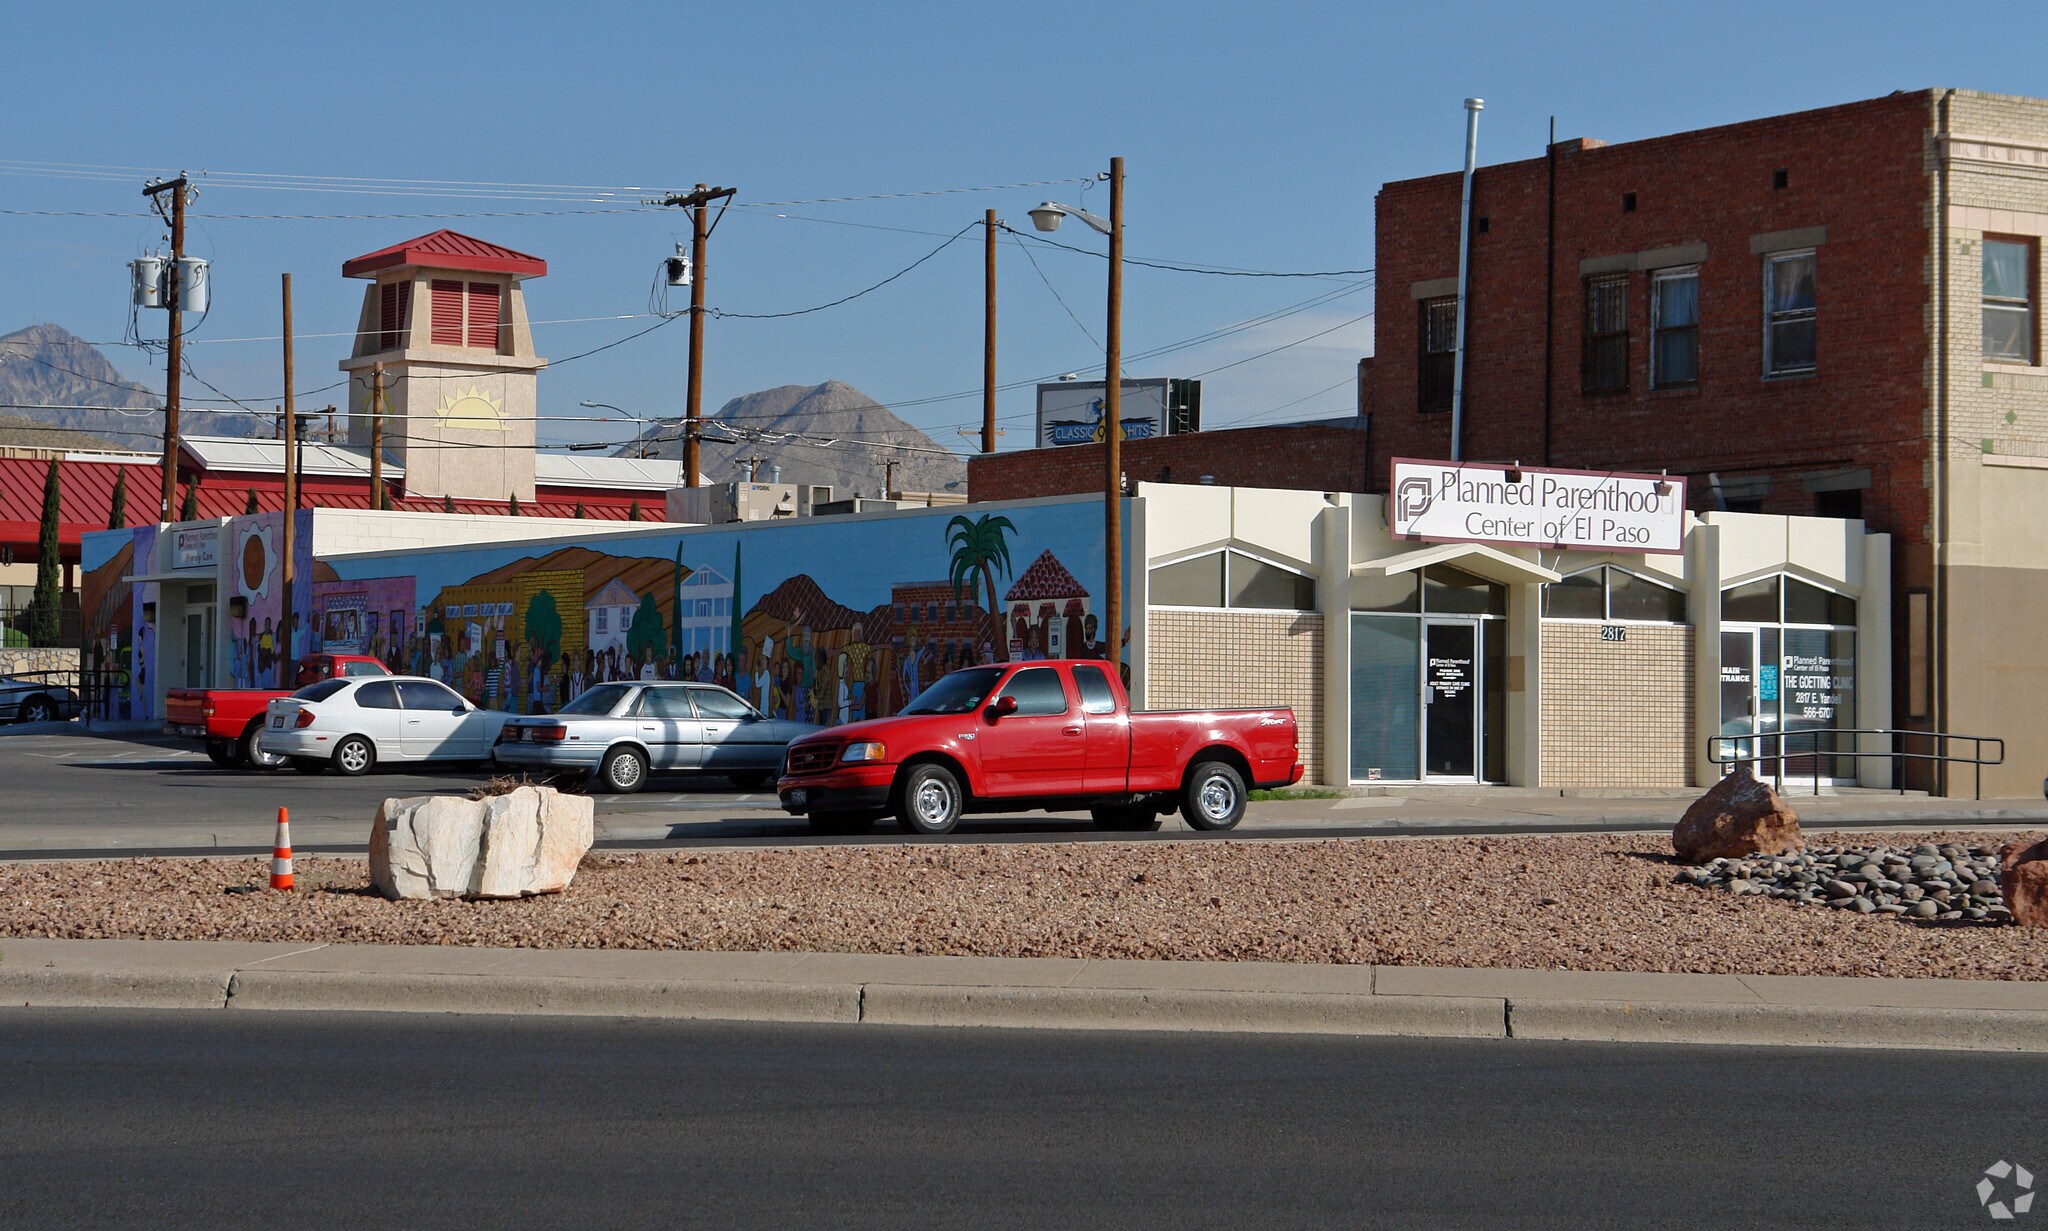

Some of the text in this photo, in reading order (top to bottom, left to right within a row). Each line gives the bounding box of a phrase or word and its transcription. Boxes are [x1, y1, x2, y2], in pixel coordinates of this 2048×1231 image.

[1055, 426, 1094, 439] CLASSIC
[1127, 424, 1149, 437] HITS
[1441, 469, 1534, 506] Planned
[1465, 511, 1650, 544] Center of El Paso
[203, 551, 213, 561] Care
[1602, 626, 1626, 641] 2817
[1793, 655, 1818, 665] Planned
[1721, 666, 1740, 674] MAIN
[1720, 674, 1750, 682] TRANCE
[1784, 675, 1854, 689] THE GOETTING CLINIC
[1795, 691, 1842, 704] 2817 E. Yandell
[1803, 706, 1834, 718] 566-6707
